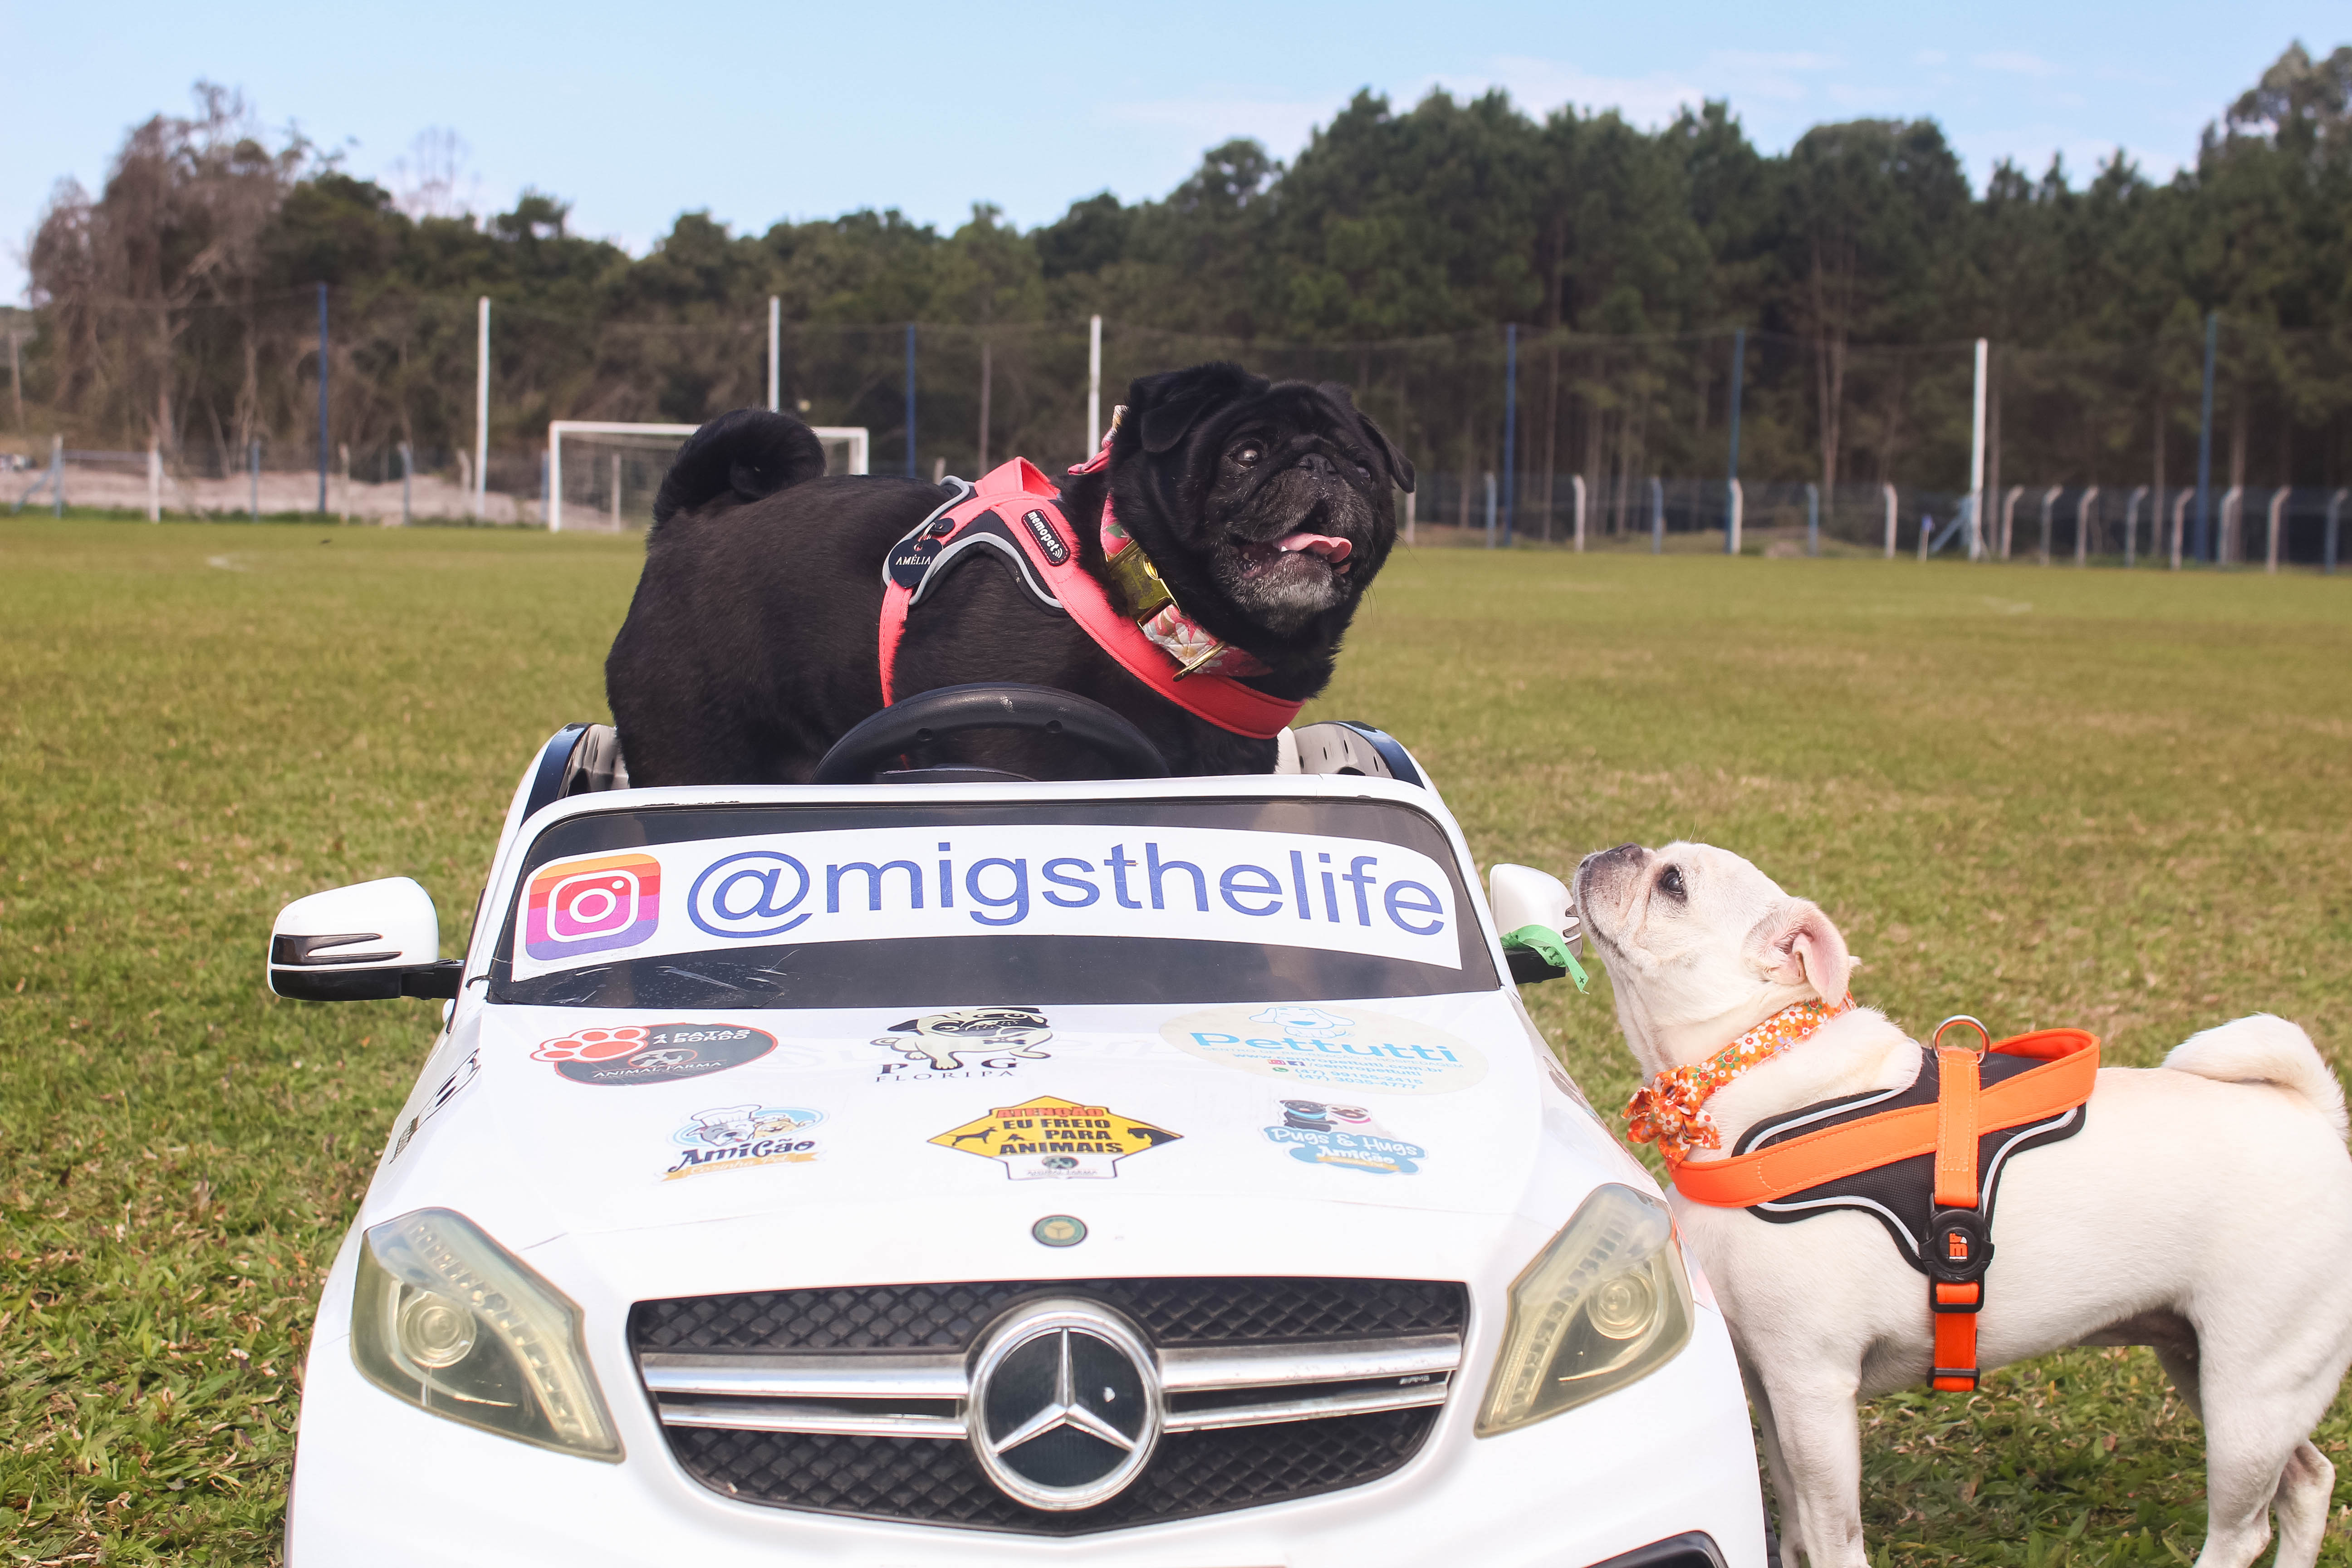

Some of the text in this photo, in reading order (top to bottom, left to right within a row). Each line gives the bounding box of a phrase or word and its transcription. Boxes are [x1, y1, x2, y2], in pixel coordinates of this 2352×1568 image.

[1027, 510, 1059, 553] memopet
[895, 554, 931, 565] AMÉLIA
[687, 841, 1446, 937] @migsthelife
[672, 1034, 748, 1043] BORDO
[674, 1029, 751, 1039] PATAS
[1189, 1032, 1459, 1062] Pettutti
[592, 1067, 661, 1078] ANIMAL
[875, 1070, 1014, 1083] FLORIPA
[996, 1107, 1104, 1118] ATENÇÃO
[1003, 1119, 1111, 1129] EU FREIO
[1044, 1130, 1112, 1139] PARA
[1272, 1128, 1418, 1156] Pugs & Hugs
[1000, 1142, 1124, 1154] ANIMAIS
